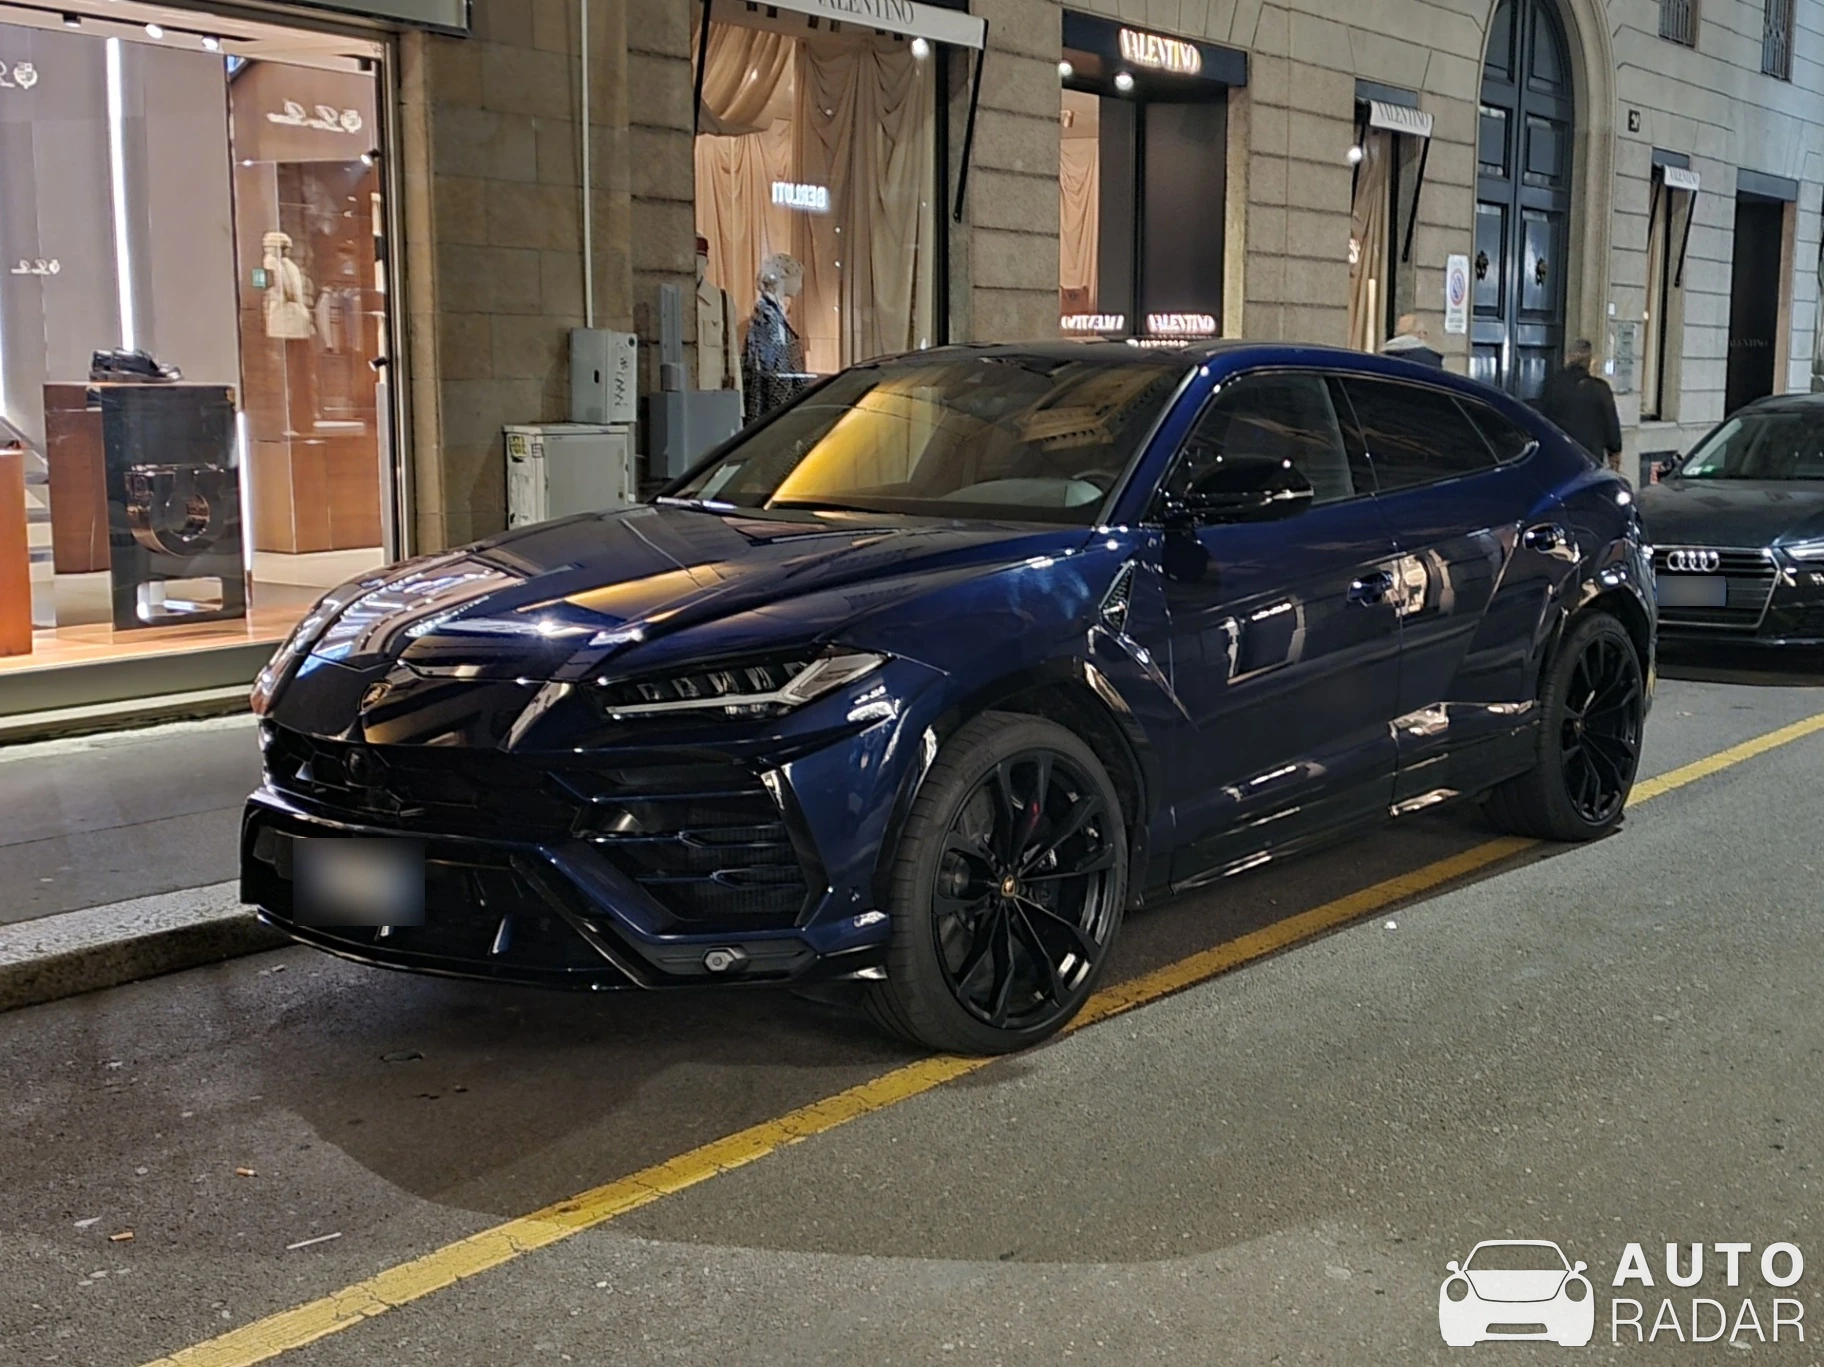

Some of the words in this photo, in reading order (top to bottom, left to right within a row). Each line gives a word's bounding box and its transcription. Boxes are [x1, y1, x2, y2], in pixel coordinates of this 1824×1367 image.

[816, 0, 914, 25] ENTINO
[1120, 28, 1201, 74] VALENTINO
[1377, 101, 1430, 129] VALENTINO
